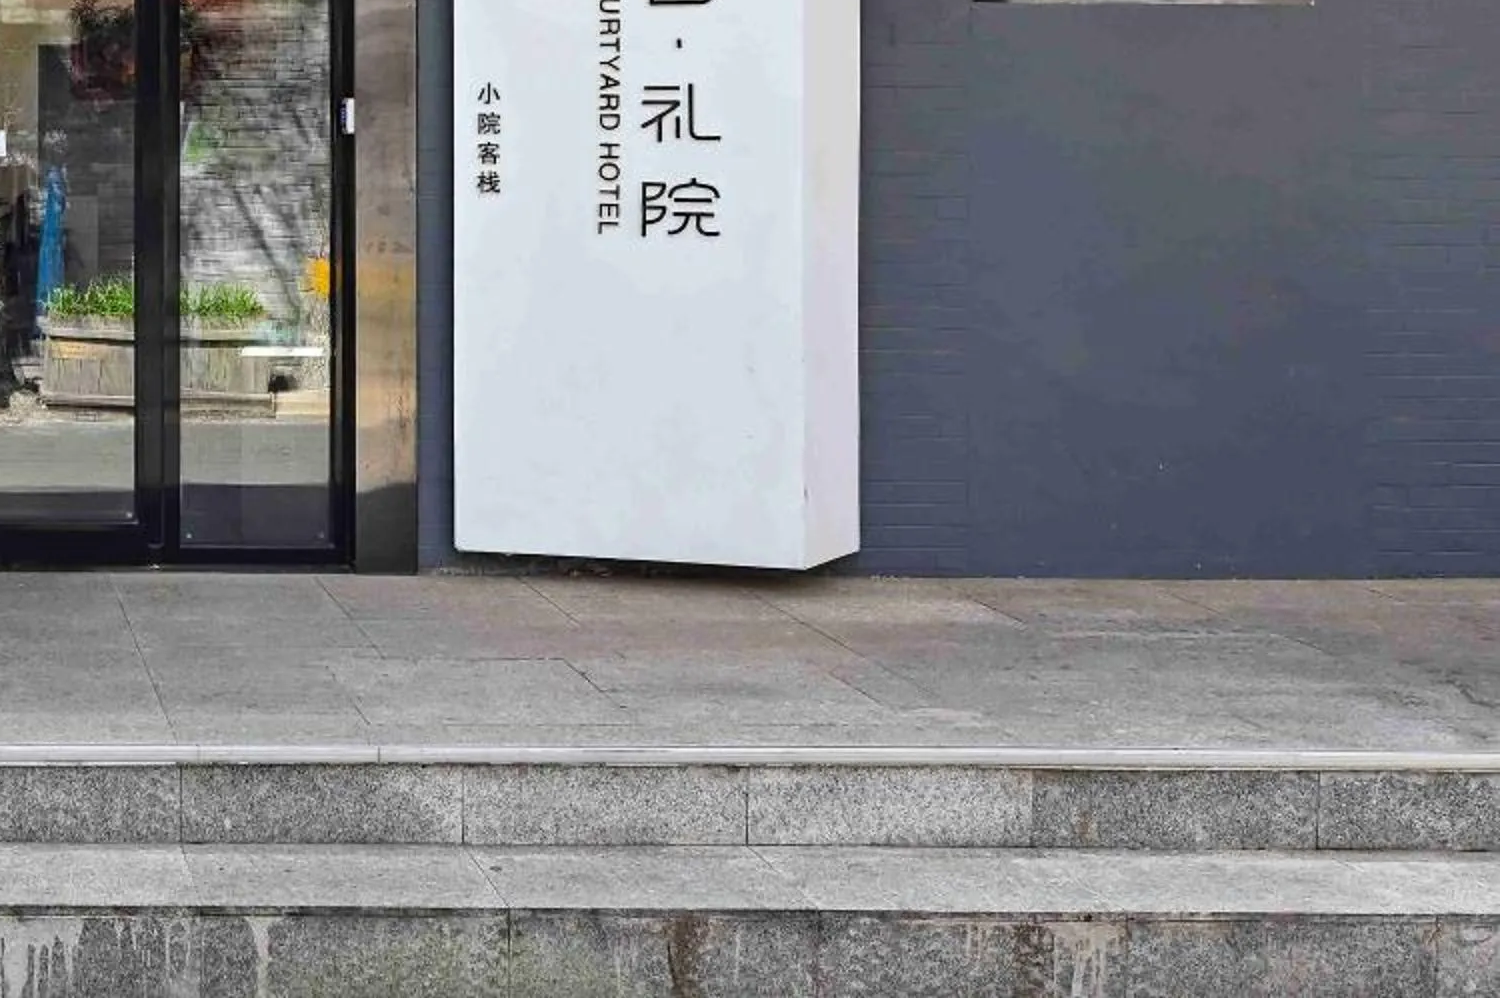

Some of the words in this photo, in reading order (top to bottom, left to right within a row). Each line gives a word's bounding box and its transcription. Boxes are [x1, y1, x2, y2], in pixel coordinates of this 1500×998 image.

[476, 82, 501, 194] 小院客栈
[597, 142, 621, 235] HOTEL
